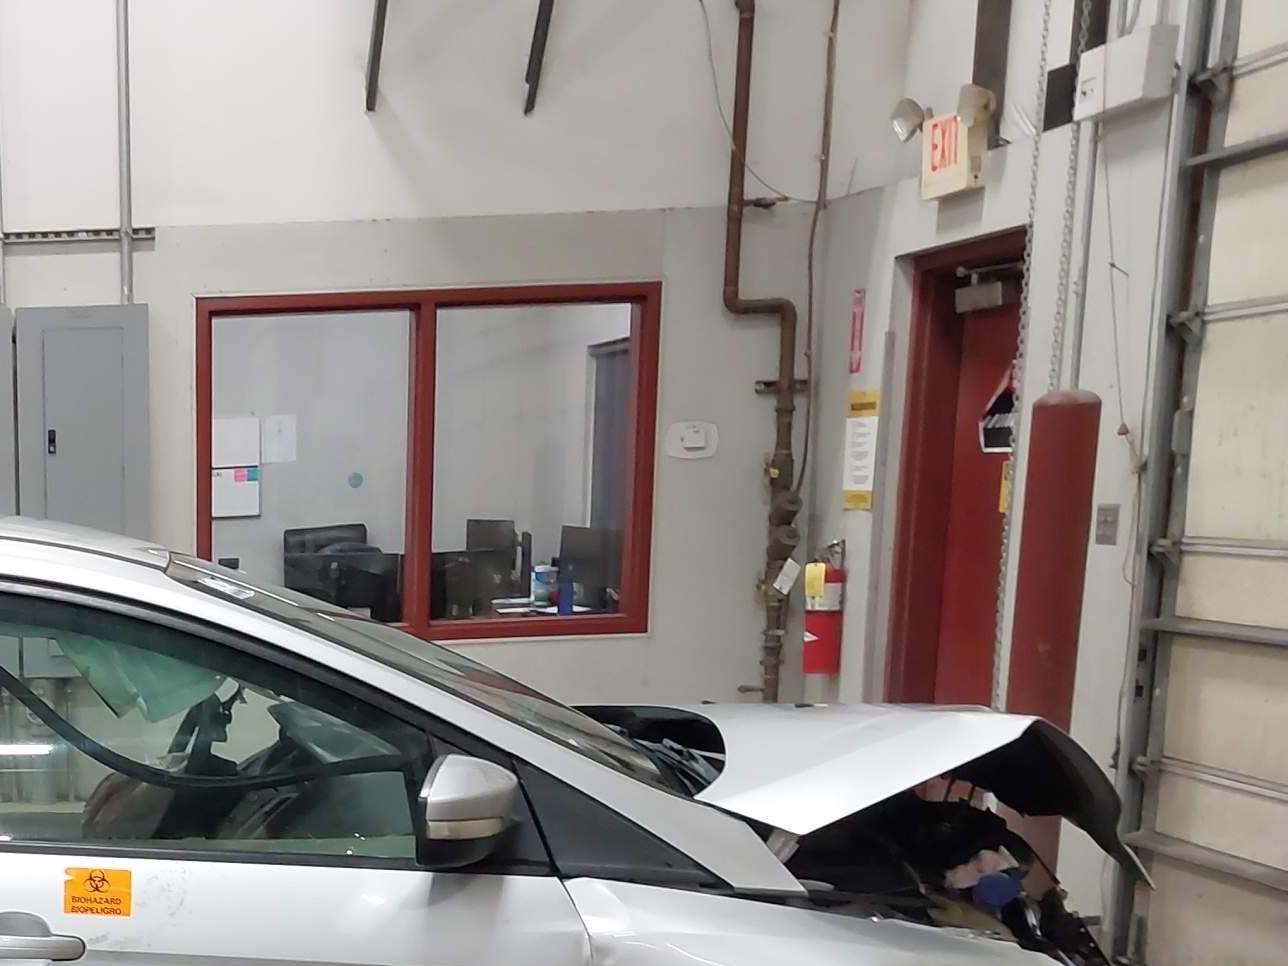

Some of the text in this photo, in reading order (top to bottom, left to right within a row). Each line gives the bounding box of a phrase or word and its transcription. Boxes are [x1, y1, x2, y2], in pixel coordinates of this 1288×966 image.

[931, 115, 959, 172] EXIT
[71, 895, 122, 906] BIOHAZARD
[71, 905, 122, 916] BIOPELIGRO
